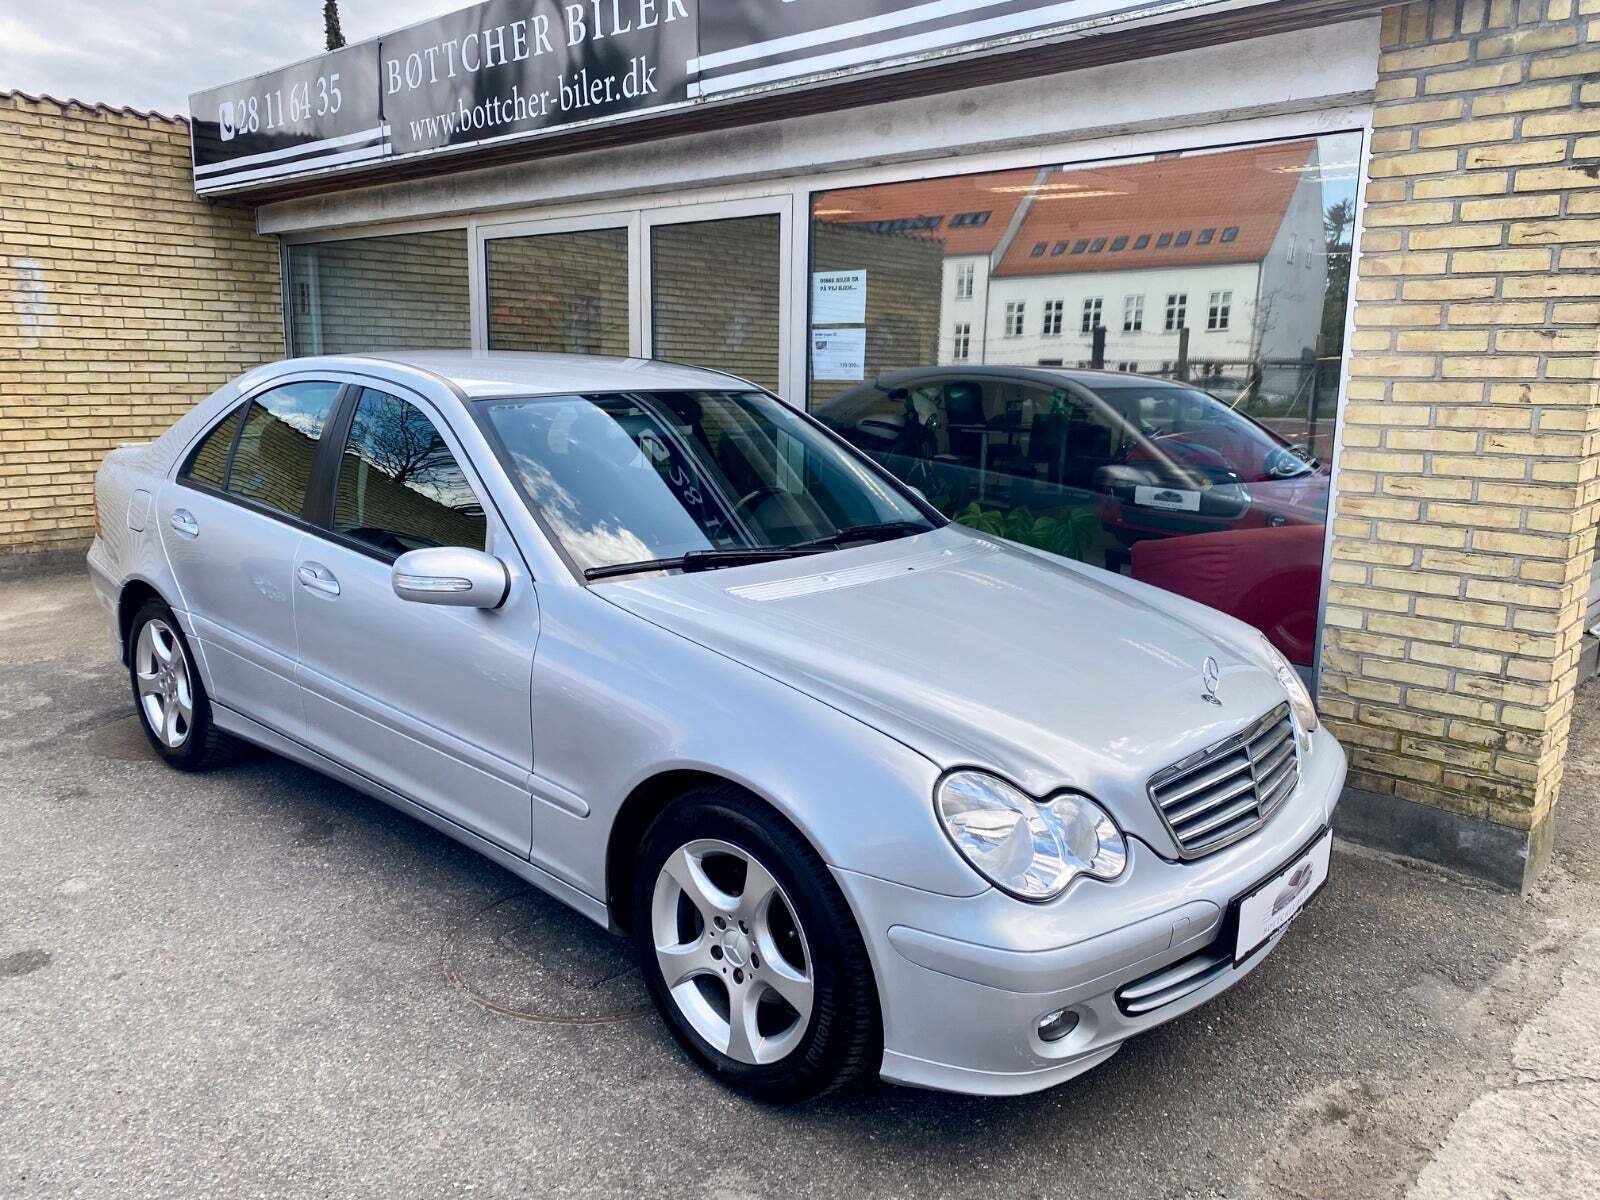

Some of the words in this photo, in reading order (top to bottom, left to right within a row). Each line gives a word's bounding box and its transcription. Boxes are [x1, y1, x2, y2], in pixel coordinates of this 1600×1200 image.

[386, 14, 553, 95] BØTTCHER
[237, 96, 260, 136] 28
[265, 91, 285, 129] 11
[289, 82, 313, 124] 64
[316, 73, 343, 117] 35
[409, 56, 657, 143] www.bottcher-biler.dk
